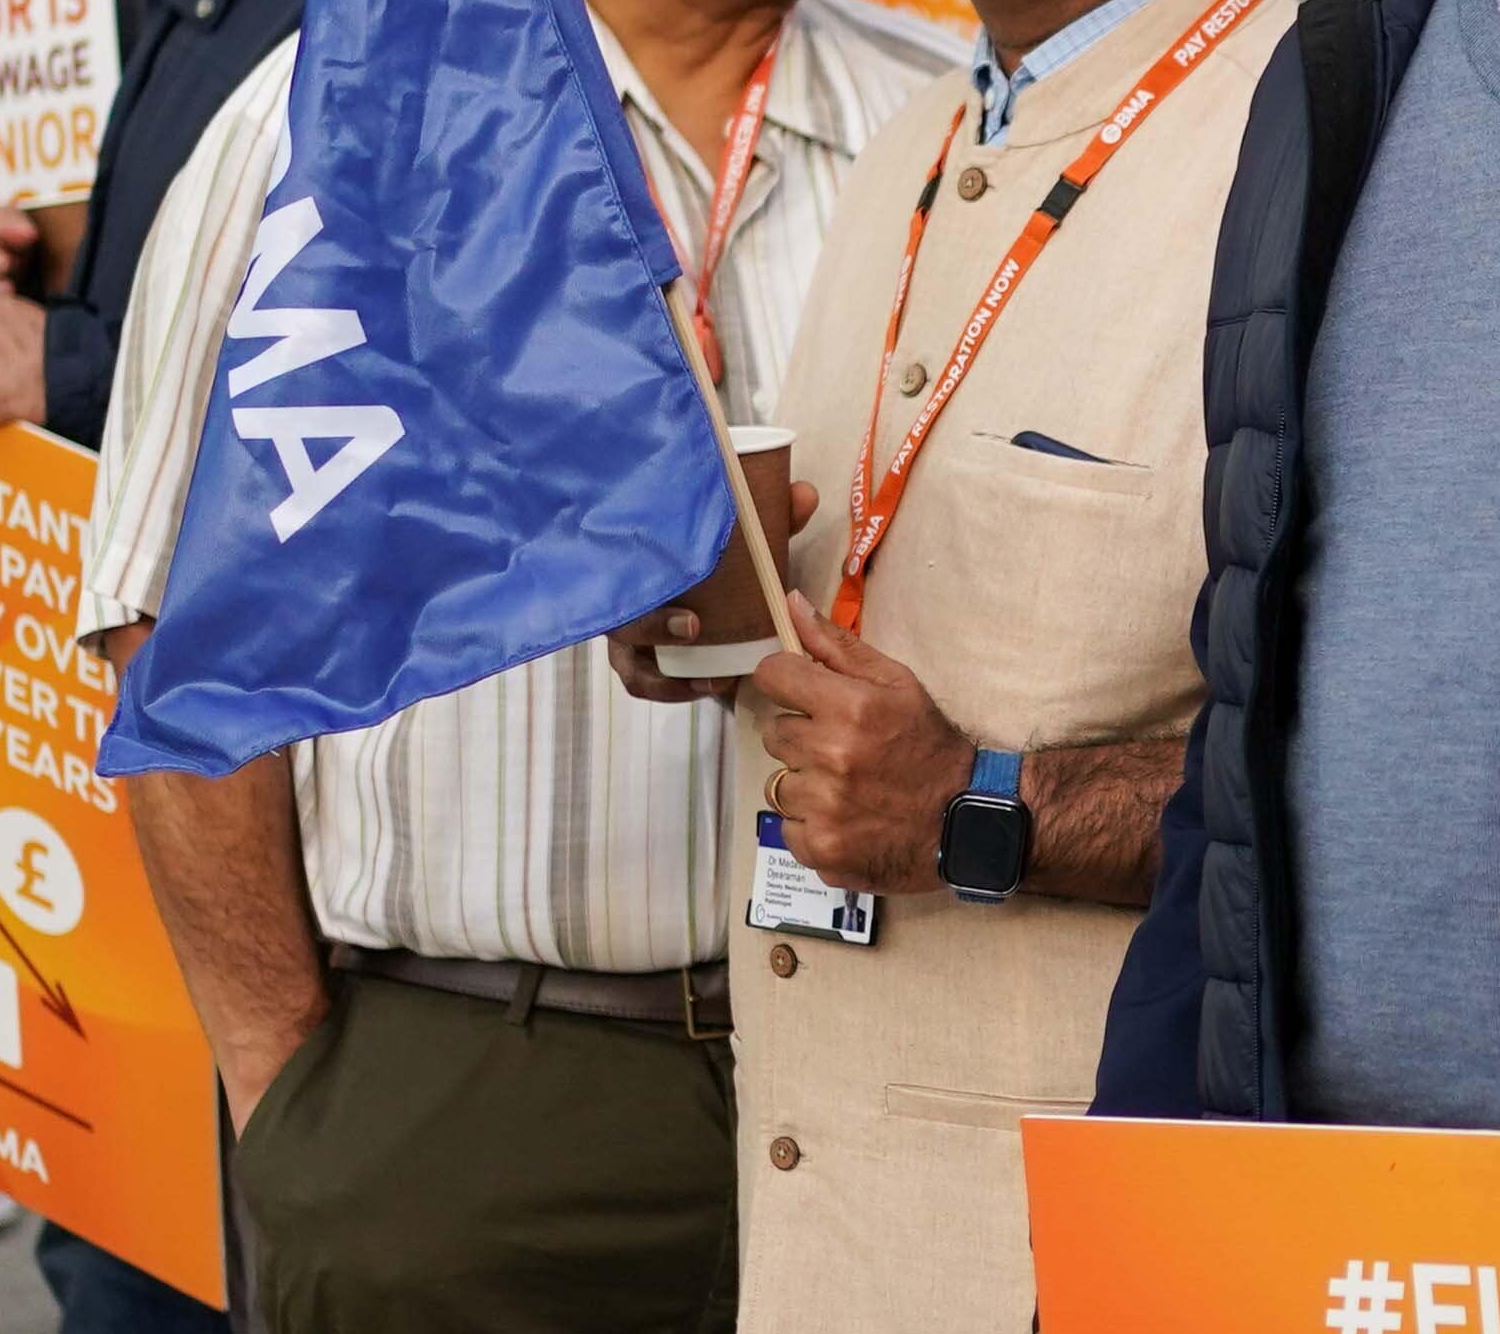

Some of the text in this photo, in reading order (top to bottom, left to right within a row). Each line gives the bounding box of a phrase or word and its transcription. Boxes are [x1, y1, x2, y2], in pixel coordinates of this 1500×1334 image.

[1173, 30, 1208, 67] PAY
[1114, 89, 1156, 129] BMA
[227, 107, 406, 544] MA
[890, 258, 1021, 475] PAY RESTORATION NOW
[856, 514, 885, 556] BMA
[1, 544, 77, 615] PAY
